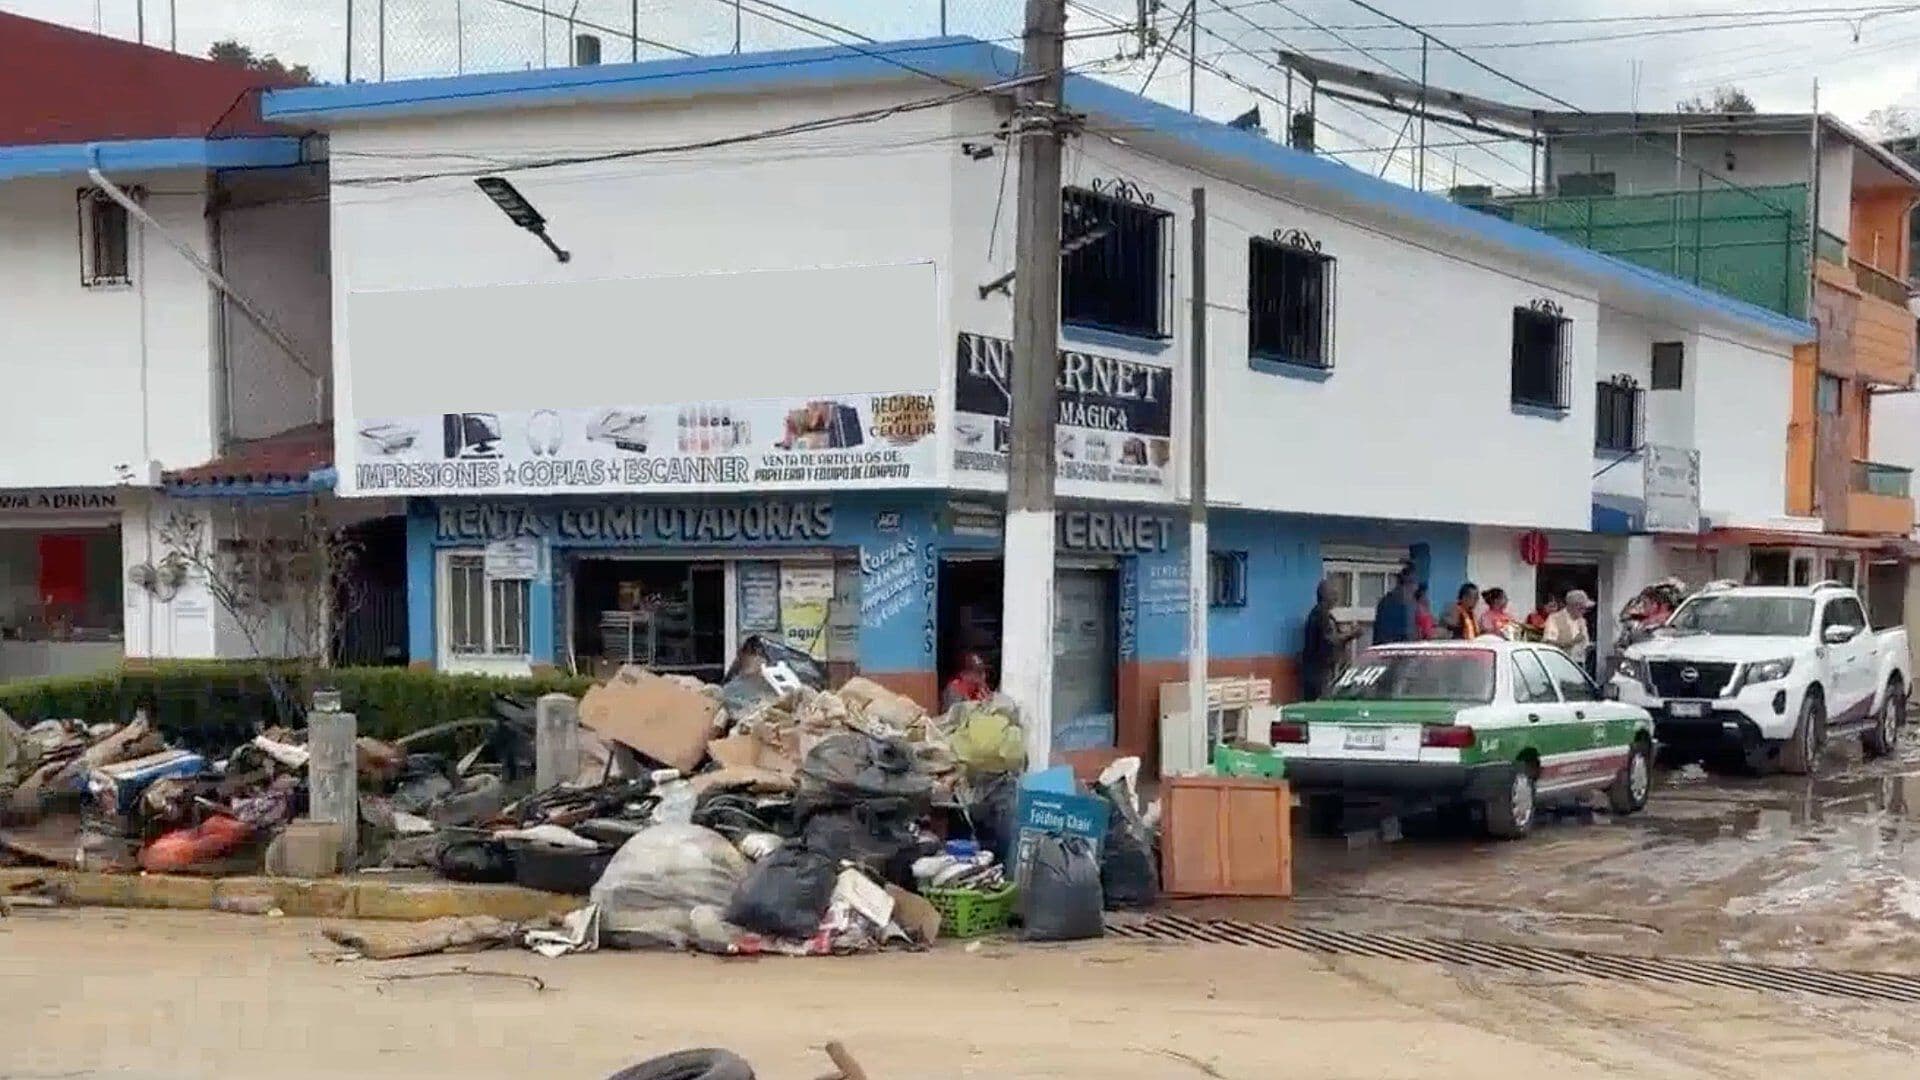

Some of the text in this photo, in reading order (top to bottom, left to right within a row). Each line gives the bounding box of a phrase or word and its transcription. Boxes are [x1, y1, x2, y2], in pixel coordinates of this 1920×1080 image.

[968, 334, 1160, 404] INRNET
[871, 395, 935, 414] RECARGA
[355, 456, 749, 490] IMPRESIONES COPIAS ESCANNER
[763, 454, 798, 467] VENTA
[801, 453, 816, 466] DE
[818, 451, 881, 466] ARTICULOS
[38, 493, 116, 508] ADRIAN
[437, 503, 543, 538] RENTA
[561, 501, 834, 540] COMPUTADORAS
[1057, 511, 1173, 551] ERNET
[924, 542, 935, 654] COPIAS
[1030, 807, 1091, 832] Folding Chair
